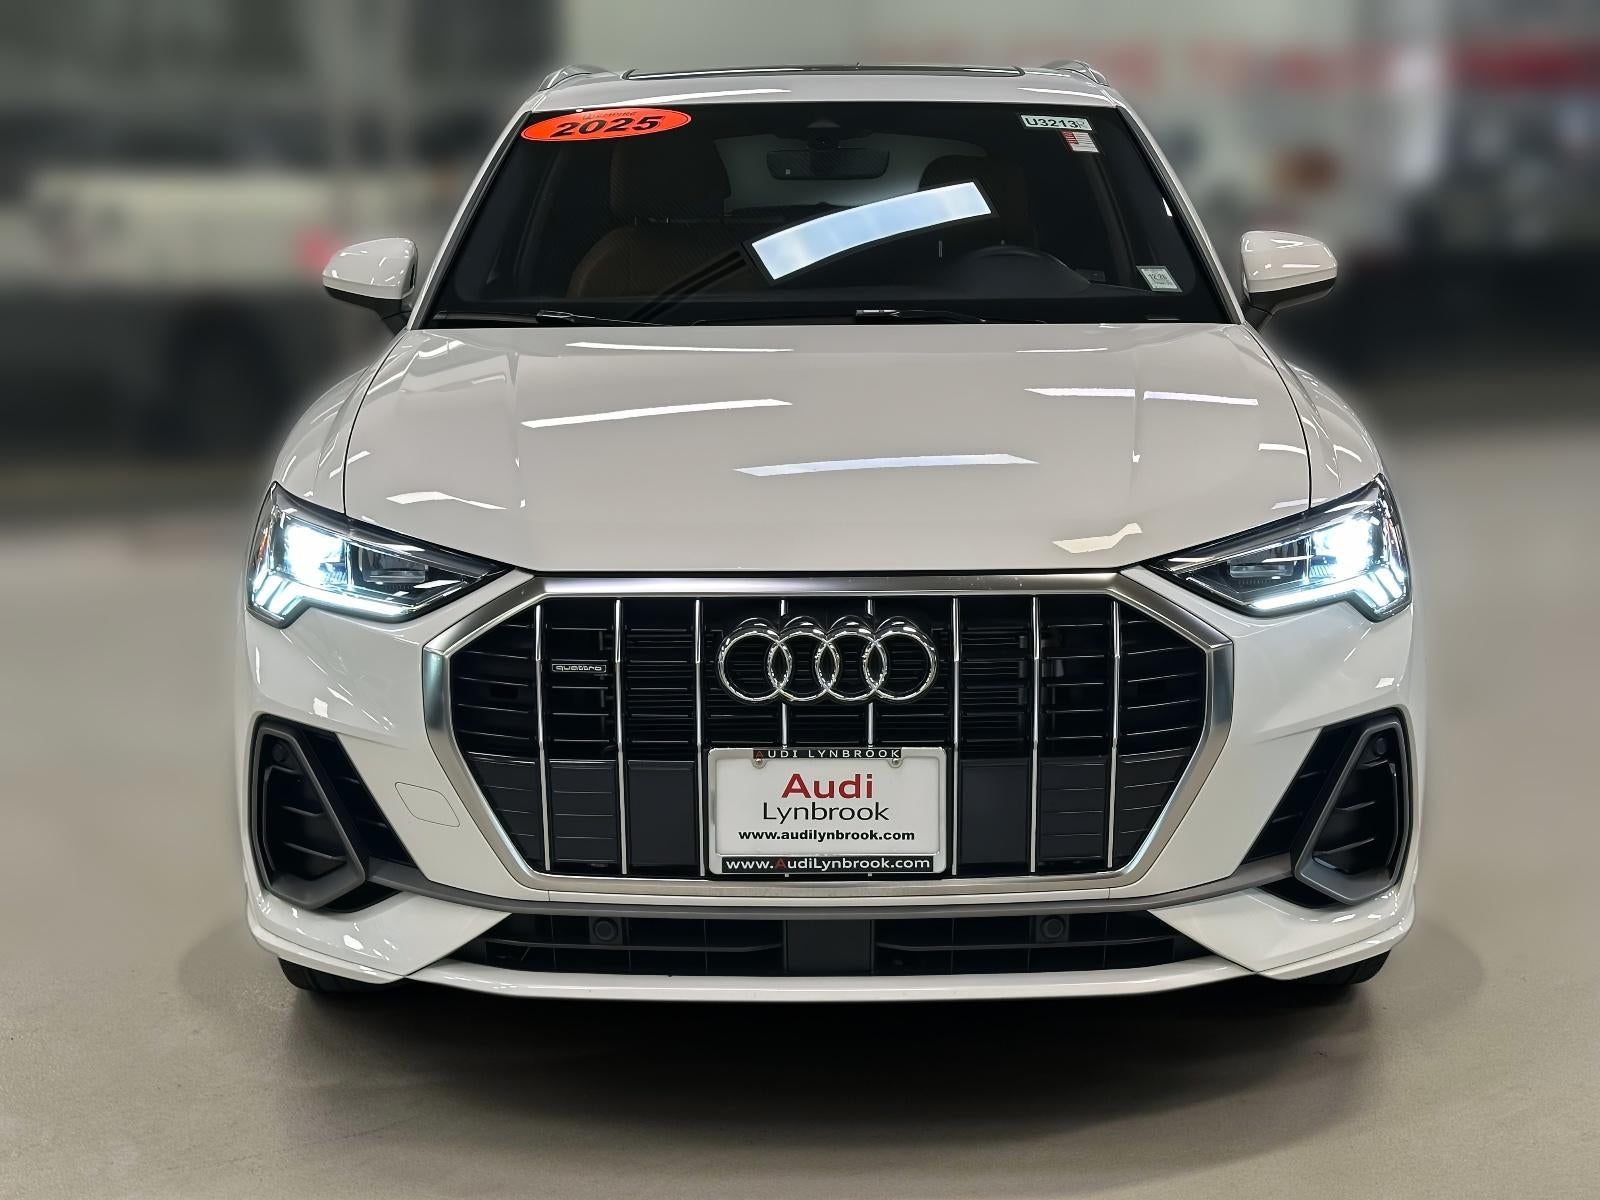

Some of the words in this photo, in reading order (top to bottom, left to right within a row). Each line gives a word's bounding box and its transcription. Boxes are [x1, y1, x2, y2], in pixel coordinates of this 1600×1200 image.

[550, 116, 665, 138] 2025
[755, 749, 798, 758] AUDI
[808, 749, 900, 758] LYNBROOK
[781, 773, 873, 799] Audi
[763, 802, 890, 824] Lynbrook
[738, 830, 915, 842] www.audilynbrook.com
[726, 858, 930, 871] www.AudiLynbrook.com
